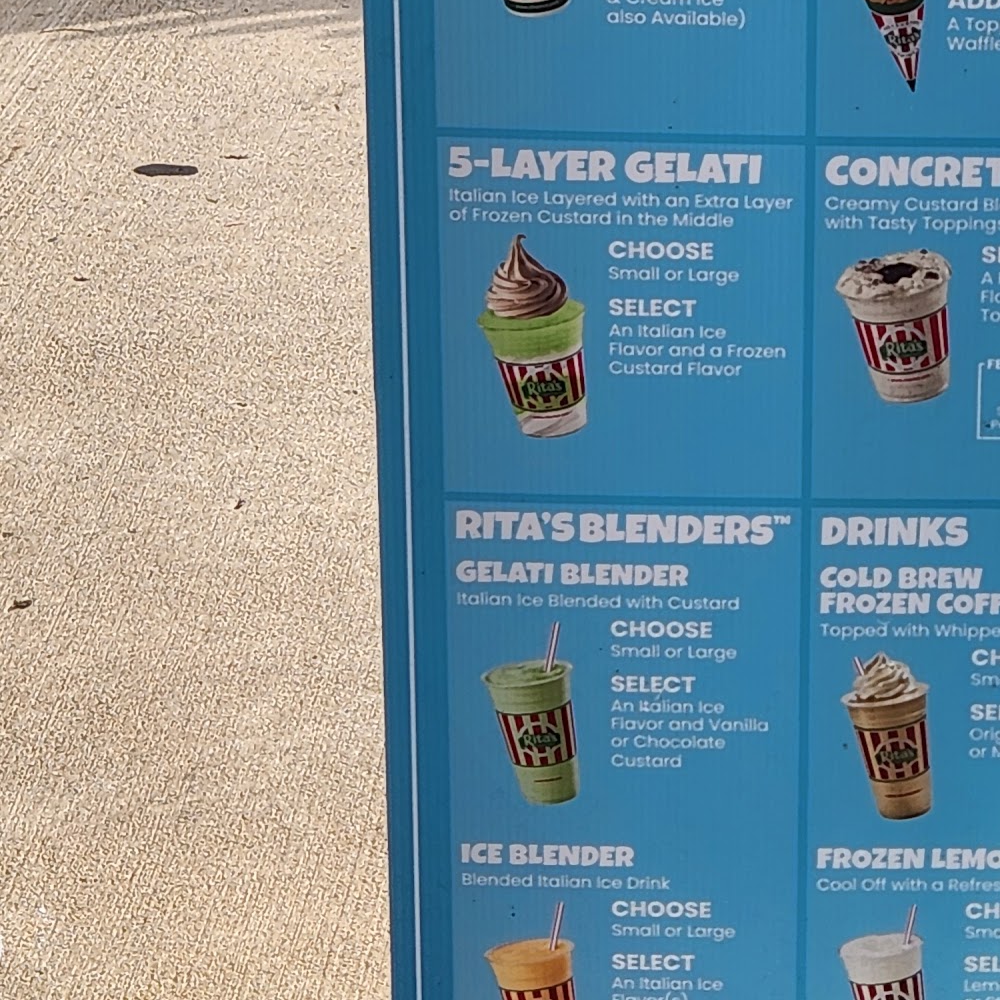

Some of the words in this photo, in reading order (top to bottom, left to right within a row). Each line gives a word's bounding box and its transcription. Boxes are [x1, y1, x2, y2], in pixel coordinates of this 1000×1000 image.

[607, 10, 646, 24] also
[651, 9, 746, 28] Available)
[947, 18, 960, 31] A
[449, 146, 615, 181] 5-LAYER
[624, 151, 762, 184] GELATI
[450, 189, 506, 202] Italian
[512, 191, 538, 204] Ice
[544, 191, 616, 209] Layered
[622, 193, 660, 207] with
[665, 195, 689, 208] an
[695, 194, 738, 208] Extra
[744, 196, 793, 213] Layer
[825, 197, 899, 214] Creamy
[904, 198, 978, 212] Custard
[450, 208, 468, 222] of
[473, 208, 532, 222] Frozen
[537, 210, 611, 224] Custard
[617, 212, 632, 224] in
[637, 213, 668, 226] the
[673, 213, 733, 227] Middle
[825, 216, 863, 229] with
[868, 216, 916, 233] Tasty
[609, 241, 714, 260] CHOOSE
[609, 299, 696, 317] SELECT
[456, 510, 574, 541] RITA'S
[821, 517, 968, 547] DRINKS
[456, 561, 553, 583] GELATI
[561, 563, 688, 586] BLENDER
[820, 566, 891, 588] COLD
[899, 567, 983, 589] BREW
[458, 593, 511, 605] Italian
[517, 594, 543, 607] Ice
[549, 594, 621, 608] Blended
[625, 596, 663, 609] with
[668, 596, 739, 610] Custard
[820, 592, 930, 614] FROZEN
[611, 621, 712, 638] CHOOSE
[822, 624, 887, 641] Topped
[892, 624, 929, 637] with
[611, 677, 696, 693] SELECT
[612, 718, 664, 730] Flavor
[669, 718, 703, 731] and
[708, 719, 768, 732] Vanilla
[612, 736, 628, 748] or
[634, 735, 725, 749] Chocolate
[611, 754, 681, 767] Custard
[969, 747, 986, 758] or
[461, 843, 503, 864] ICE
[509, 845, 634, 867] BLENDER
[817, 848, 925, 869] FROZEN
[463, 873, 532, 887] Blended
[538, 875, 592, 888] Italian
[597, 876, 622, 889] Ice
[628, 877, 670, 890] Drink
[817, 878, 856, 892] Cool
[861, 878, 886, 892] Off
[891, 878, 927, 892] with
[932, 881, 943, 892] a
[612, 901, 711, 918] CHOOSE
